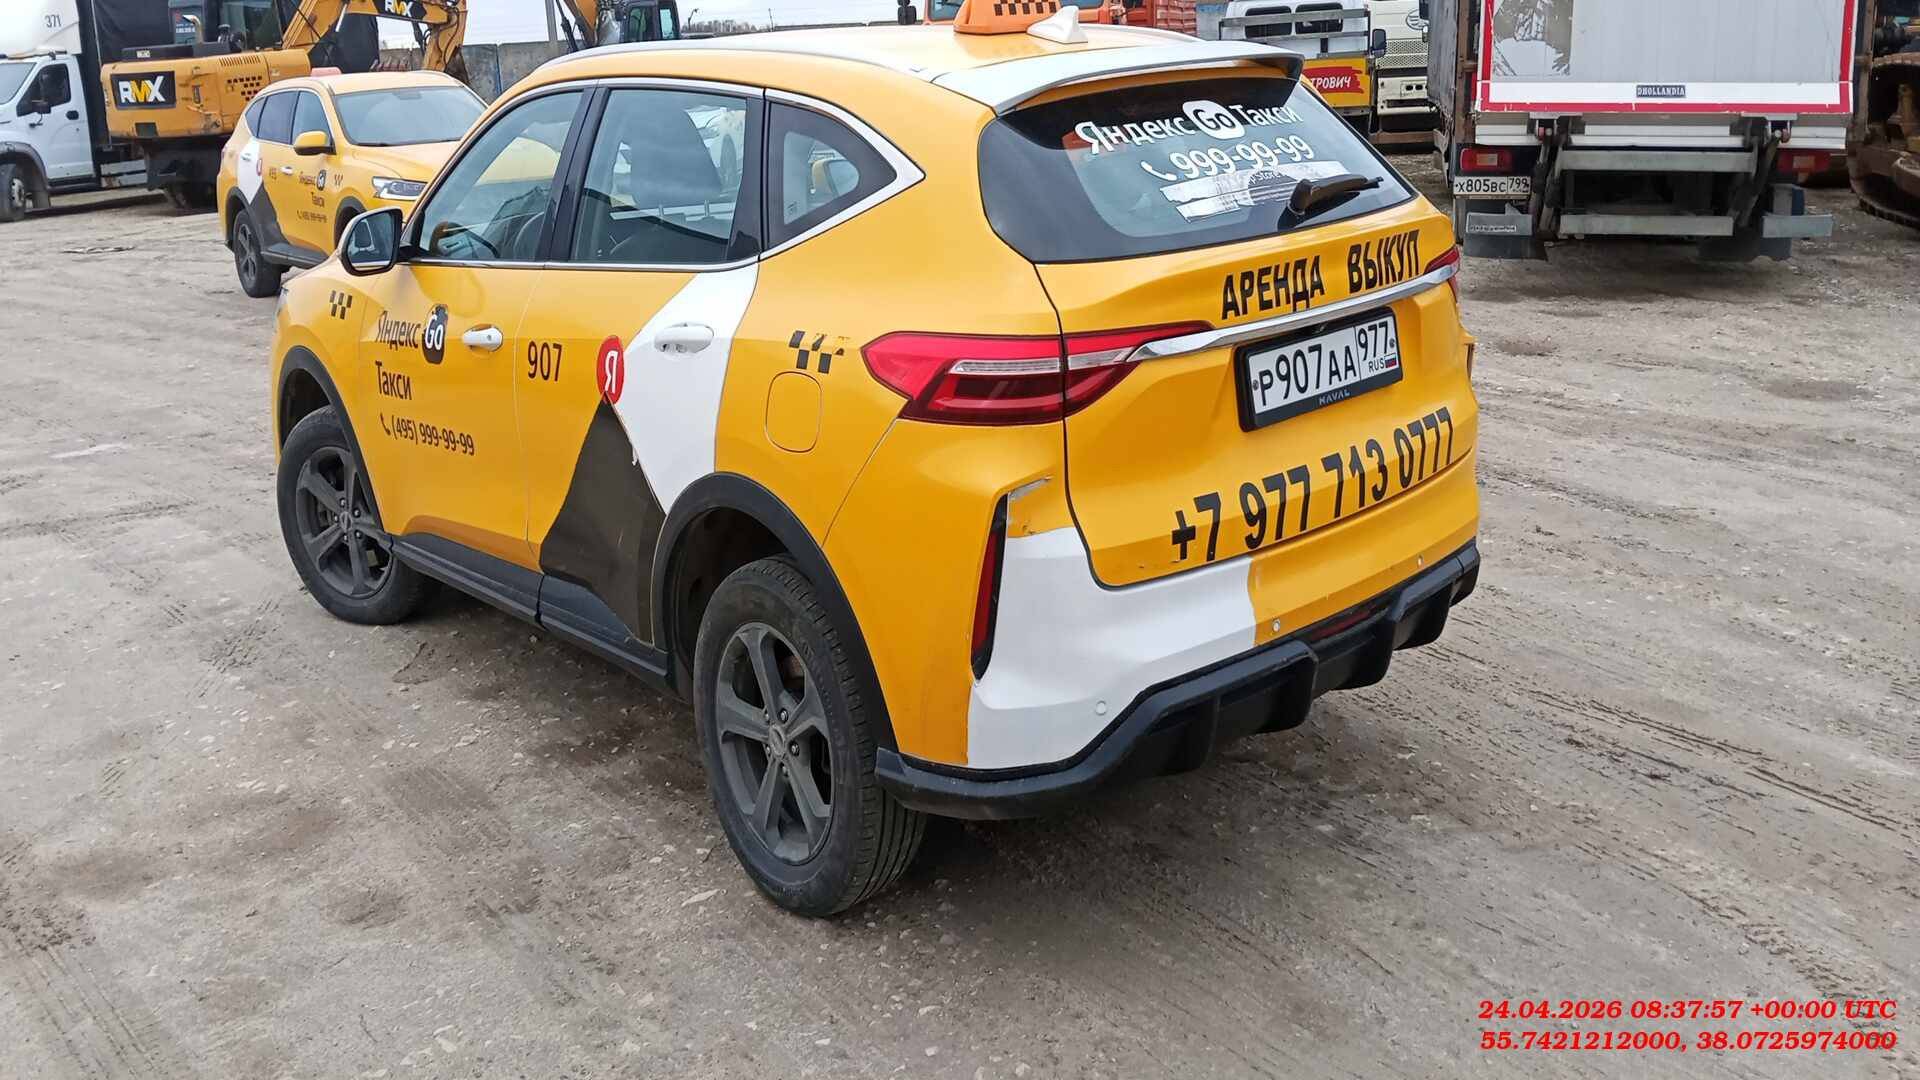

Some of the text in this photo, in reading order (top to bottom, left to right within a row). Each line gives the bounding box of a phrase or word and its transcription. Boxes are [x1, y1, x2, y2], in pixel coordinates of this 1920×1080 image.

[44, 14, 62, 28] 371
[385, 0, 413, 18] RMX
[118, 75, 166, 103] RMX
[1310, 76, 1351, 89] ТРОВИЧ
[1637, 86, 1685, 96] DHOLLANDIA
[1075, 104, 1304, 155] Яндекс Go Такси
[1169, 135, 1315, 178] 999-99-99
[1221, 229, 1420, 320] АРЕНДА ВЫКУП
[375, 310, 444, 351] Яндекс Go
[375, 361, 413, 400] Такси
[527, 340, 562, 382] 907
[604, 350, 619, 394] Я
[1258, 321, 1389, 406] Р907АА 977
[1369, 357, 1385, 373] RUS
[391, 415, 475, 456] (495) 999-99-99
[1172, 406, 1453, 562] +7 977 713 0777
